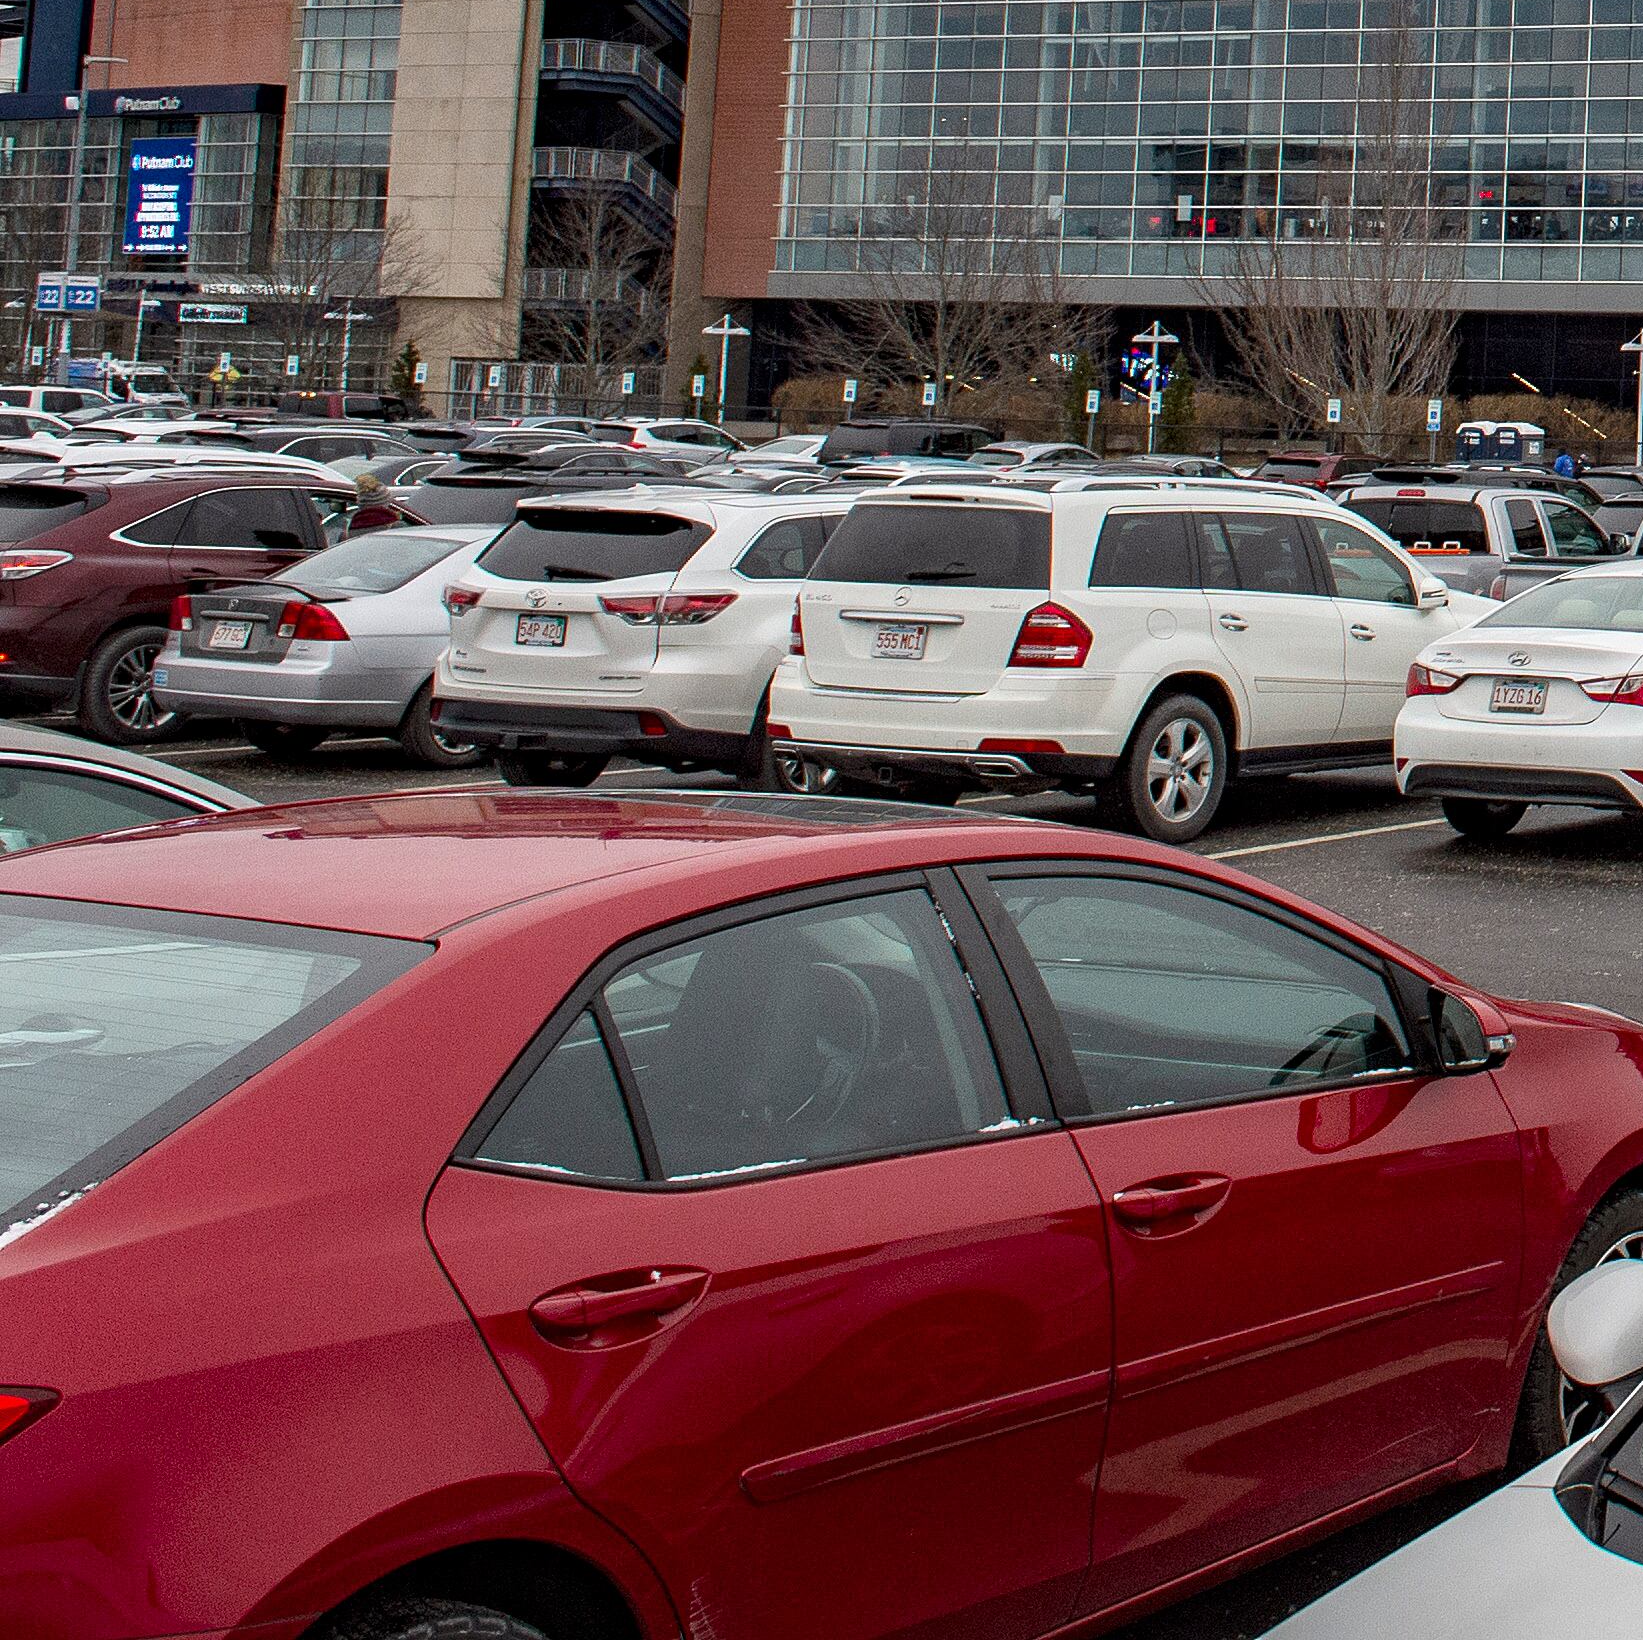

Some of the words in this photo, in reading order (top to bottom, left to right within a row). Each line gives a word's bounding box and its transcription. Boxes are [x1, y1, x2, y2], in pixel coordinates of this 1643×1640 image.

[141, 156, 174, 169] Putnam
[173, 154, 194, 168] Club
[75, 290, 94, 304] 22
[876, 632, 900, 649] 555
[1494, 687, 1525, 704] 1YZG
[1526, 689, 1542, 705] 16
